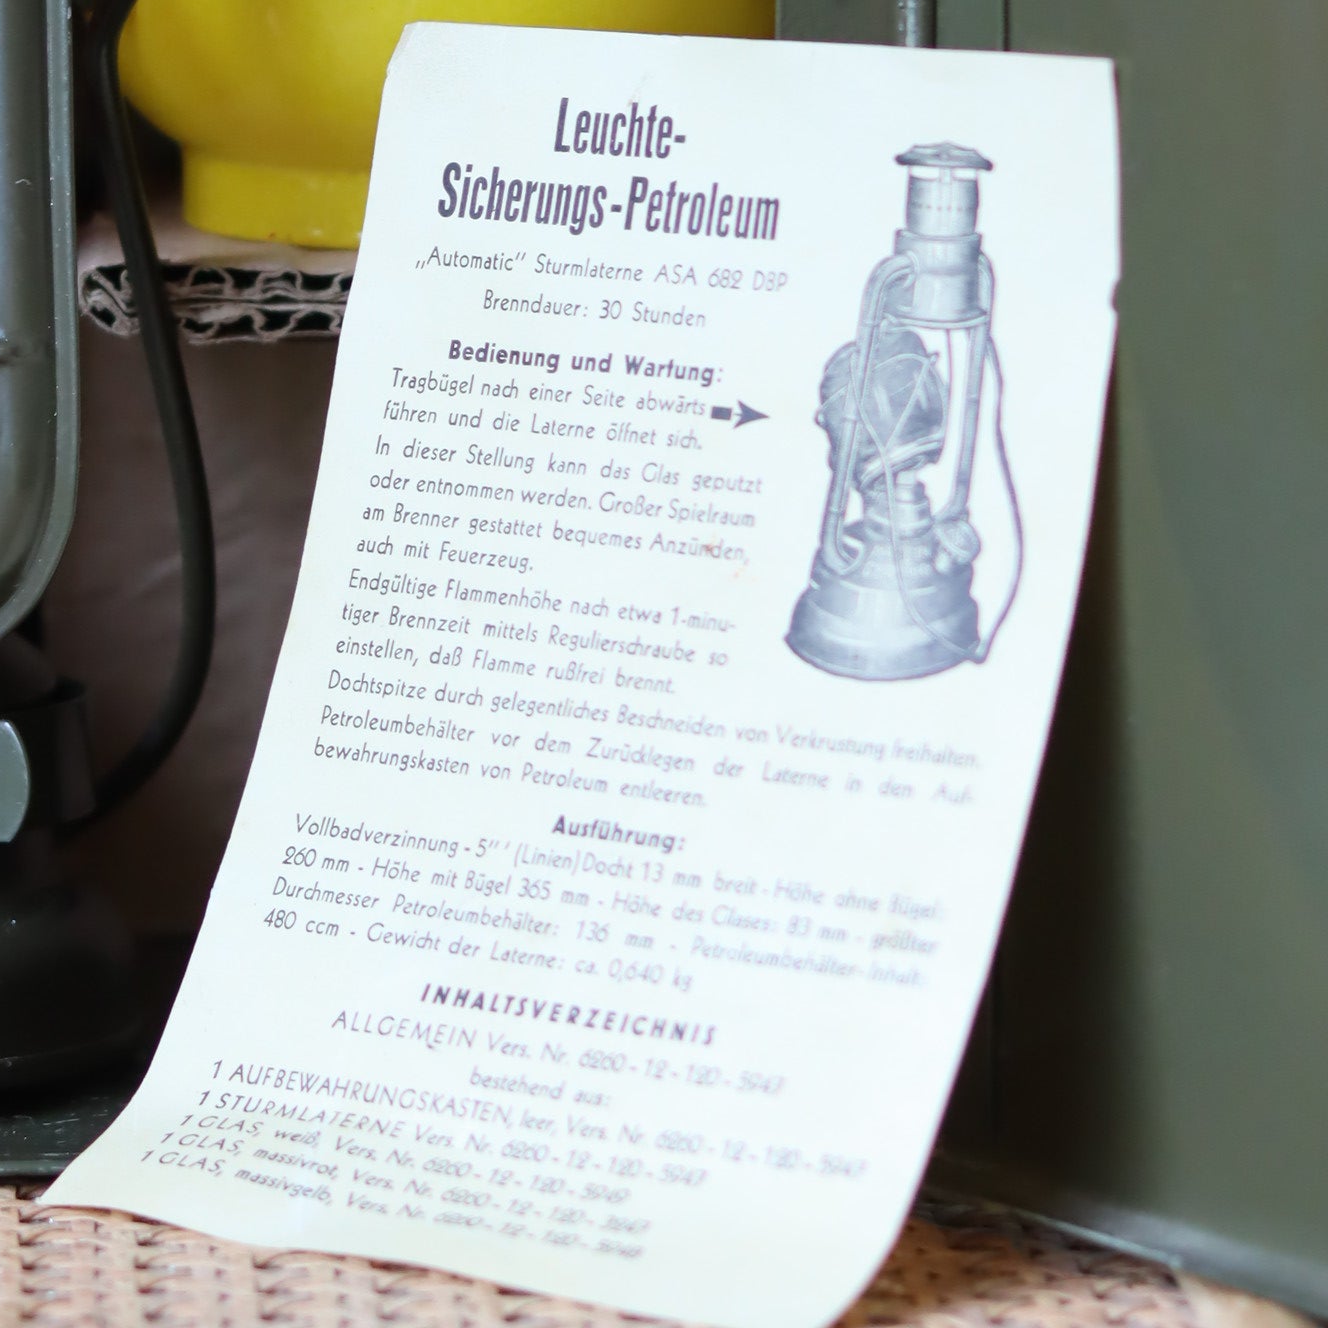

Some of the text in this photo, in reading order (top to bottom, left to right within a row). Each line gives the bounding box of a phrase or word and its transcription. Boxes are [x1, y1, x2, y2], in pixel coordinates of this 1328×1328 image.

[554, 97, 686, 159] Leuchte-
[438, 162, 779, 240] Sicherungs-Petroleum
[535, 253, 643, 281] Sturmlaterne
[654, 264, 696, 285] ASA
[709, 269, 742, 289] 682
[754, 271, 787, 291] DBP
[483, 289, 705, 326] Brenndauer: 30 Stunden
[448, 340, 722, 387] Bedienung und Wartung:
[393, 367, 704, 415] Tragbügel nach einer Seite abwärts
[384, 400, 701, 449] führen und die Laterne öffnet sich.
[376, 434, 761, 493] In dieser Stellung kann das Glas geputzt
[370, 469, 754, 526] oder entnommen werden. Großer Spielraum
[363, 507, 384, 521] am
[393, 503, 459, 528] Brenner
[468, 518, 542, 538] gestattet
[553, 515, 642, 549] bequemes
[357, 535, 533, 574] auch mit Feuerzeug.
[349, 568, 437, 599] Endgültige
[445, 579, 562, 611] Flammenhöhe
[571, 599, 608, 616] nach
[618, 606, 661, 624] etwa
[342, 604, 727, 665] tiger Brennzeit mittels Regulierschraube so
[336, 637, 676, 692] einstellen, daß Flamme rußfrei brennt.
[328, 669, 426, 699] Dochtspitze
[435, 683, 483, 706] durch
[491, 691, 608, 721] gelegentliches
[618, 704, 724, 736] Beschneiden
[736, 729, 767, 741] von
[314, 736, 709, 809] bewahrungskasten von Petroleum entleeren.
[321, 705, 474, 741] Petroleumbehälter
[492, 733, 520, 746] vor
[535, 732, 570, 752] dem
[586, 737, 694, 772] Zurücklegen
[715, 755, 743, 776] der
[763, 759, 828, 788] Laterne
[846, 772, 861, 791] in
[297, 813, 458, 858] Vollbadverzinnung
[644, 862, 663, 882] 13
[676, 873, 701, 887] mm
[715, 869, 756, 894] breit
[552, 815, 684, 854] Ausführung:
[282, 846, 316, 867] 260
[322, 858, 349, 872] mm
[372, 857, 420, 882] Höhe
[431, 873, 457, 888] mit
[465, 871, 511, 896] Bügel
[519, 878, 550, 900] 365
[562, 891, 588, 905] mm
[614, 889, 661, 916] Höhe
[672, 900, 702, 921] des
[264, 908, 296, 929] 480
[306, 920, 339, 936] ccm
[367, 922, 440, 950] Gewicht
[449, 935, 480, 956] der
[491, 943, 565, 968] Laterne:
[273, 876, 653, 948] Durchmesser Petroleumbehälter: 136 mm
[332, 1011, 478, 1047] ALLGEMEIN
[490, 1035, 532, 1056] Vers.
[421, 984, 715, 1047] INHALTSVERZEICHNIS
[213, 1060, 222, 1079] 1
[470, 1067, 568, 1099] bestehend
[180, 1115, 193, 1126] 1
[198, 1116, 263, 1136] GLAS,
[199, 1091, 210, 1106] 1
[215, 1093, 407, 1139] STURMLATERNE
[141, 1150, 154, 1161] 1
[159, 1152, 225, 1176] GLAS,
[161, 1132, 174, 1143] 1
[179, 1134, 244, 1155] GLAS,
